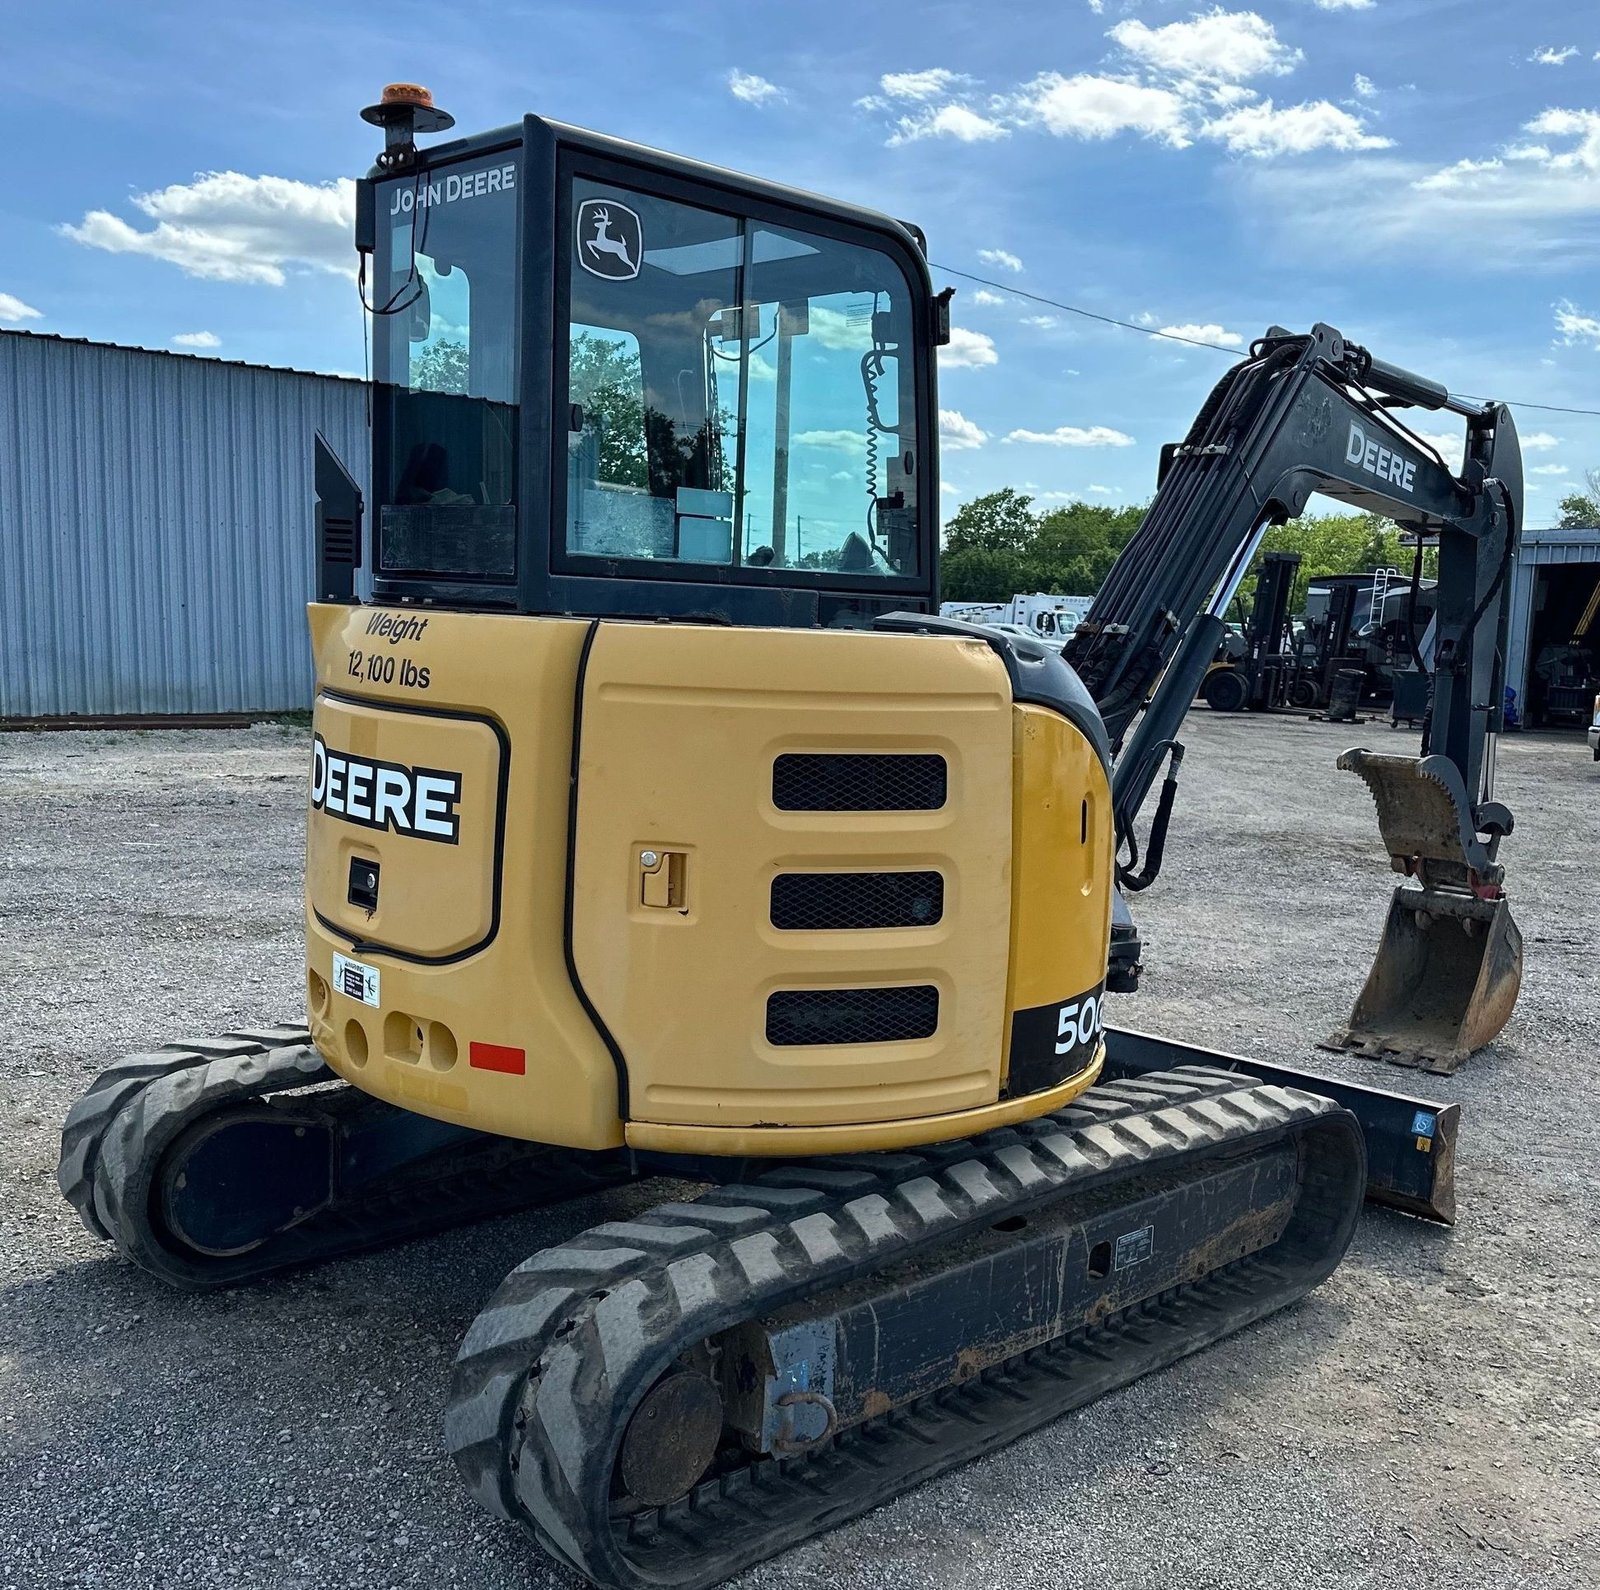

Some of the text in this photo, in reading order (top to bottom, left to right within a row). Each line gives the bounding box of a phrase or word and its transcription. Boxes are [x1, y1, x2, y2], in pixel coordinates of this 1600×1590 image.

[390, 165, 515, 215] JOHN DEERE
[1346, 424, 1417, 492] DEERE
[366, 613, 429, 644] Weight
[348, 650, 431, 689] 12,100 lbs
[312, 739, 456, 837] DEERE
